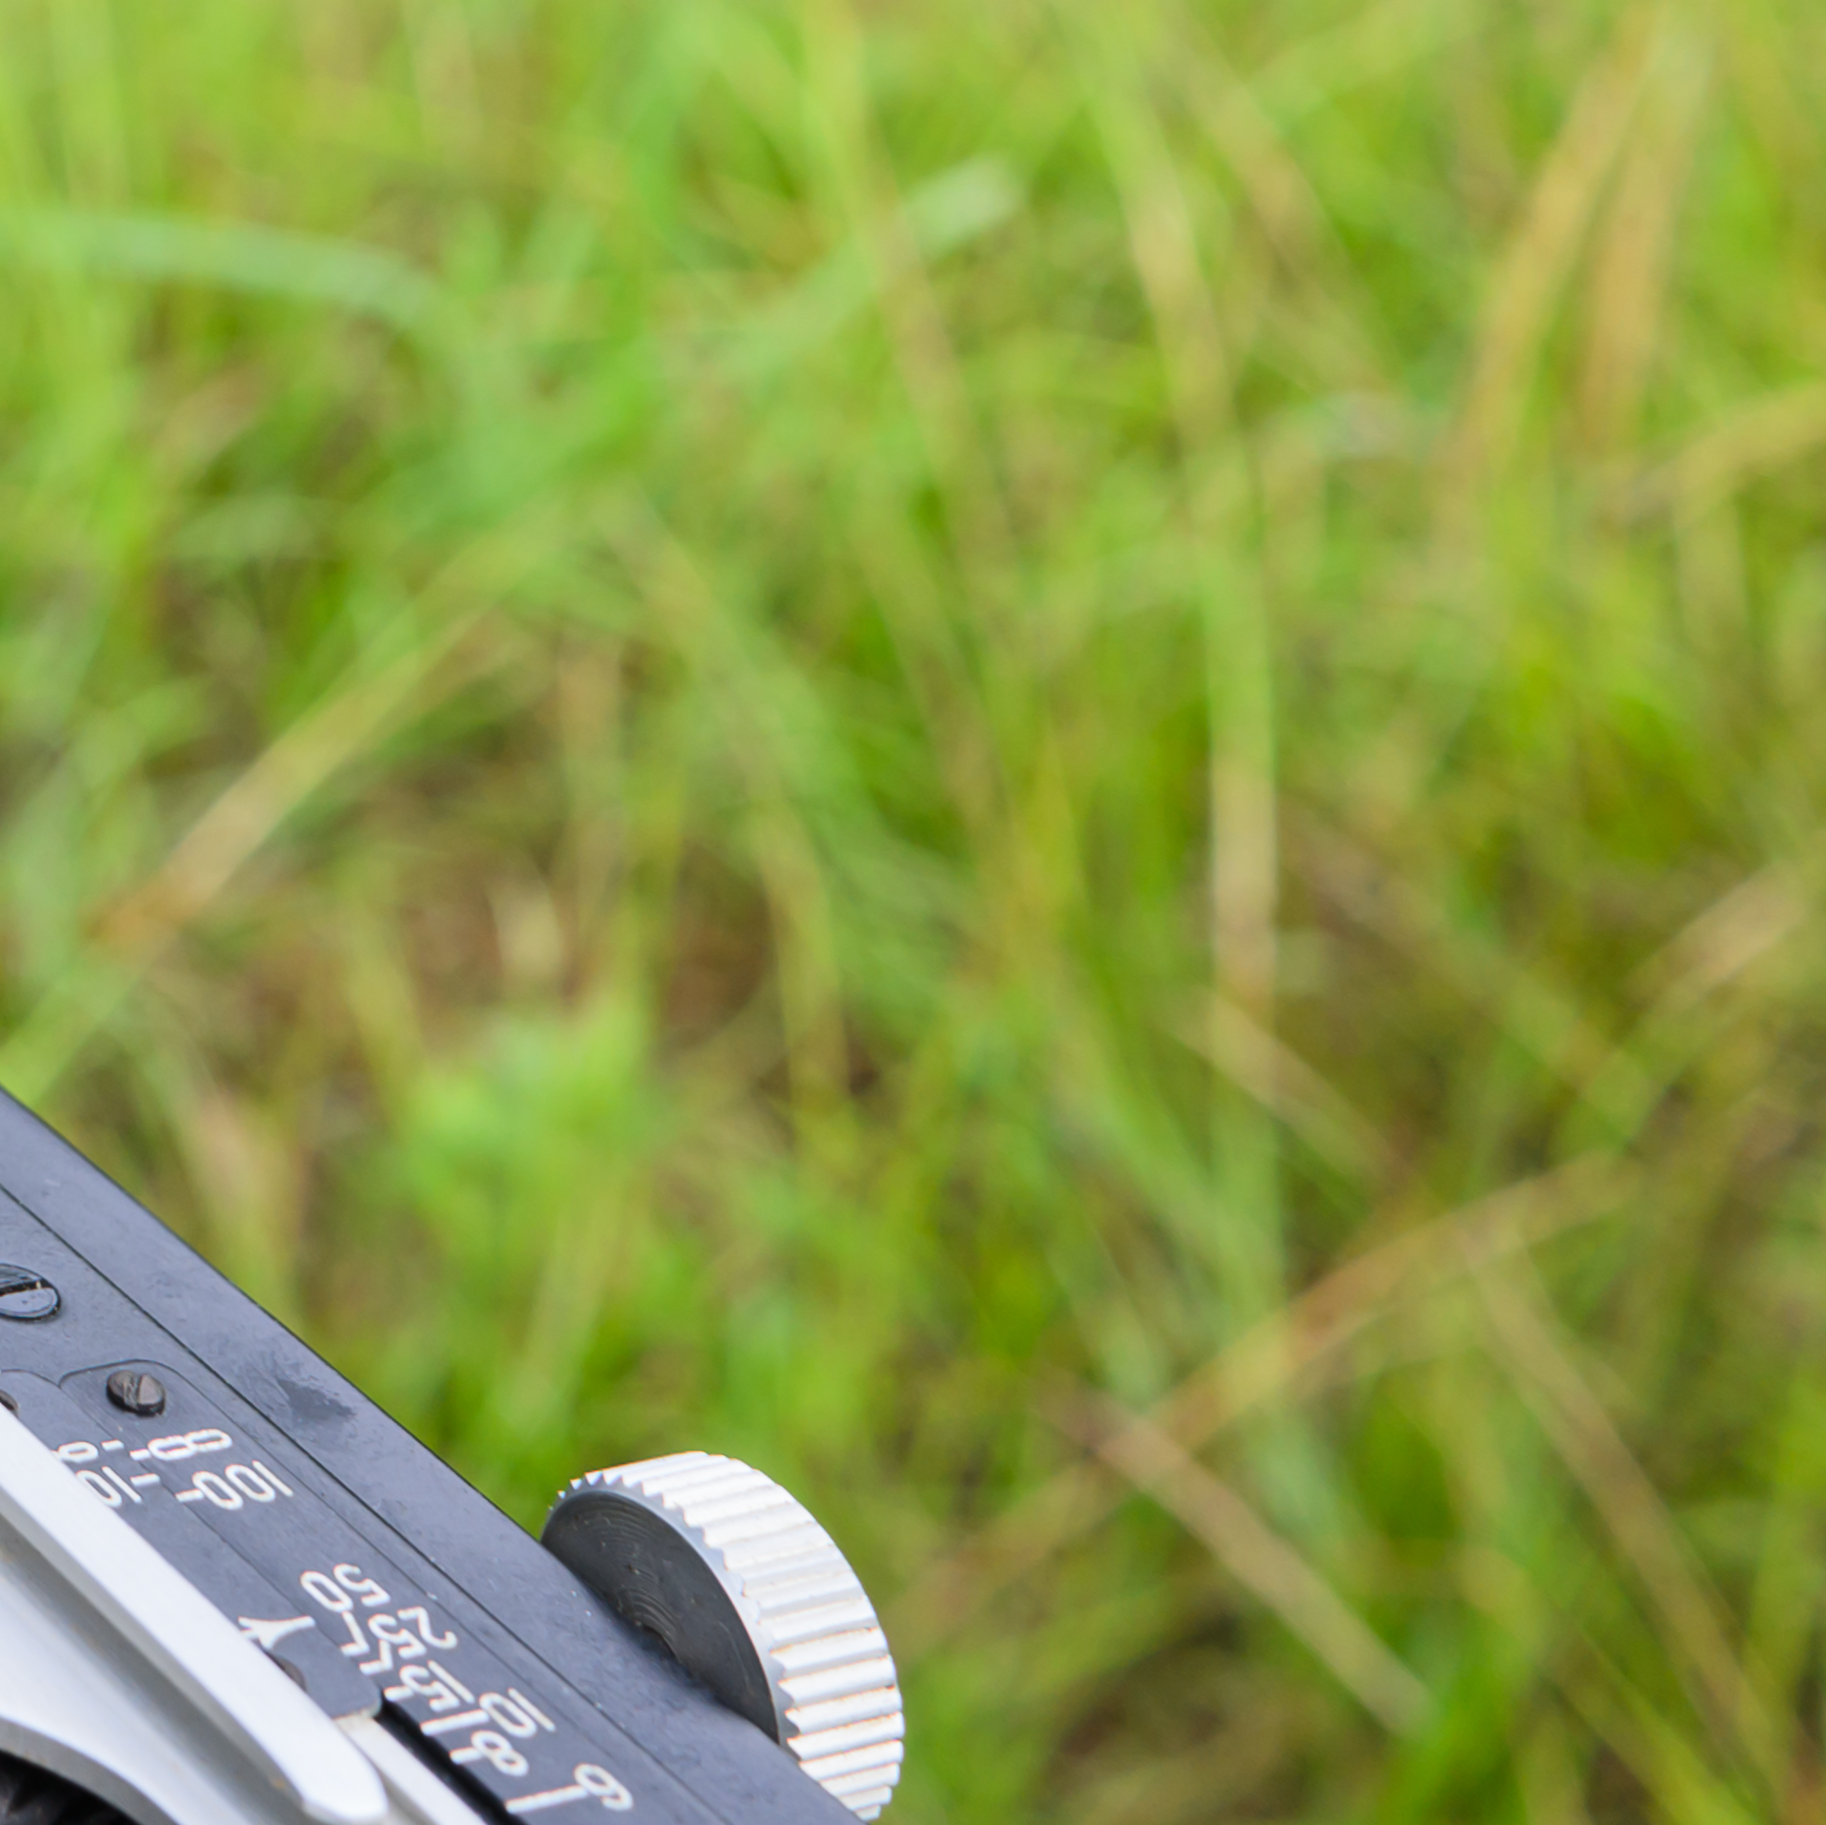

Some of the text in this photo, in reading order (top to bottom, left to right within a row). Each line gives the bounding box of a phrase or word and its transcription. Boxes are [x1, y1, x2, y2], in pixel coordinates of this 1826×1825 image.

[192, 1460, 294, 1510] 100
[300, 1563, 391, 1613] 50
[367, 1605, 458, 1659] 25
[399, 1660, 475, 1712] 15
[479, 1688, 556, 1738] 10
[471, 1730, 530, 1777] 8
